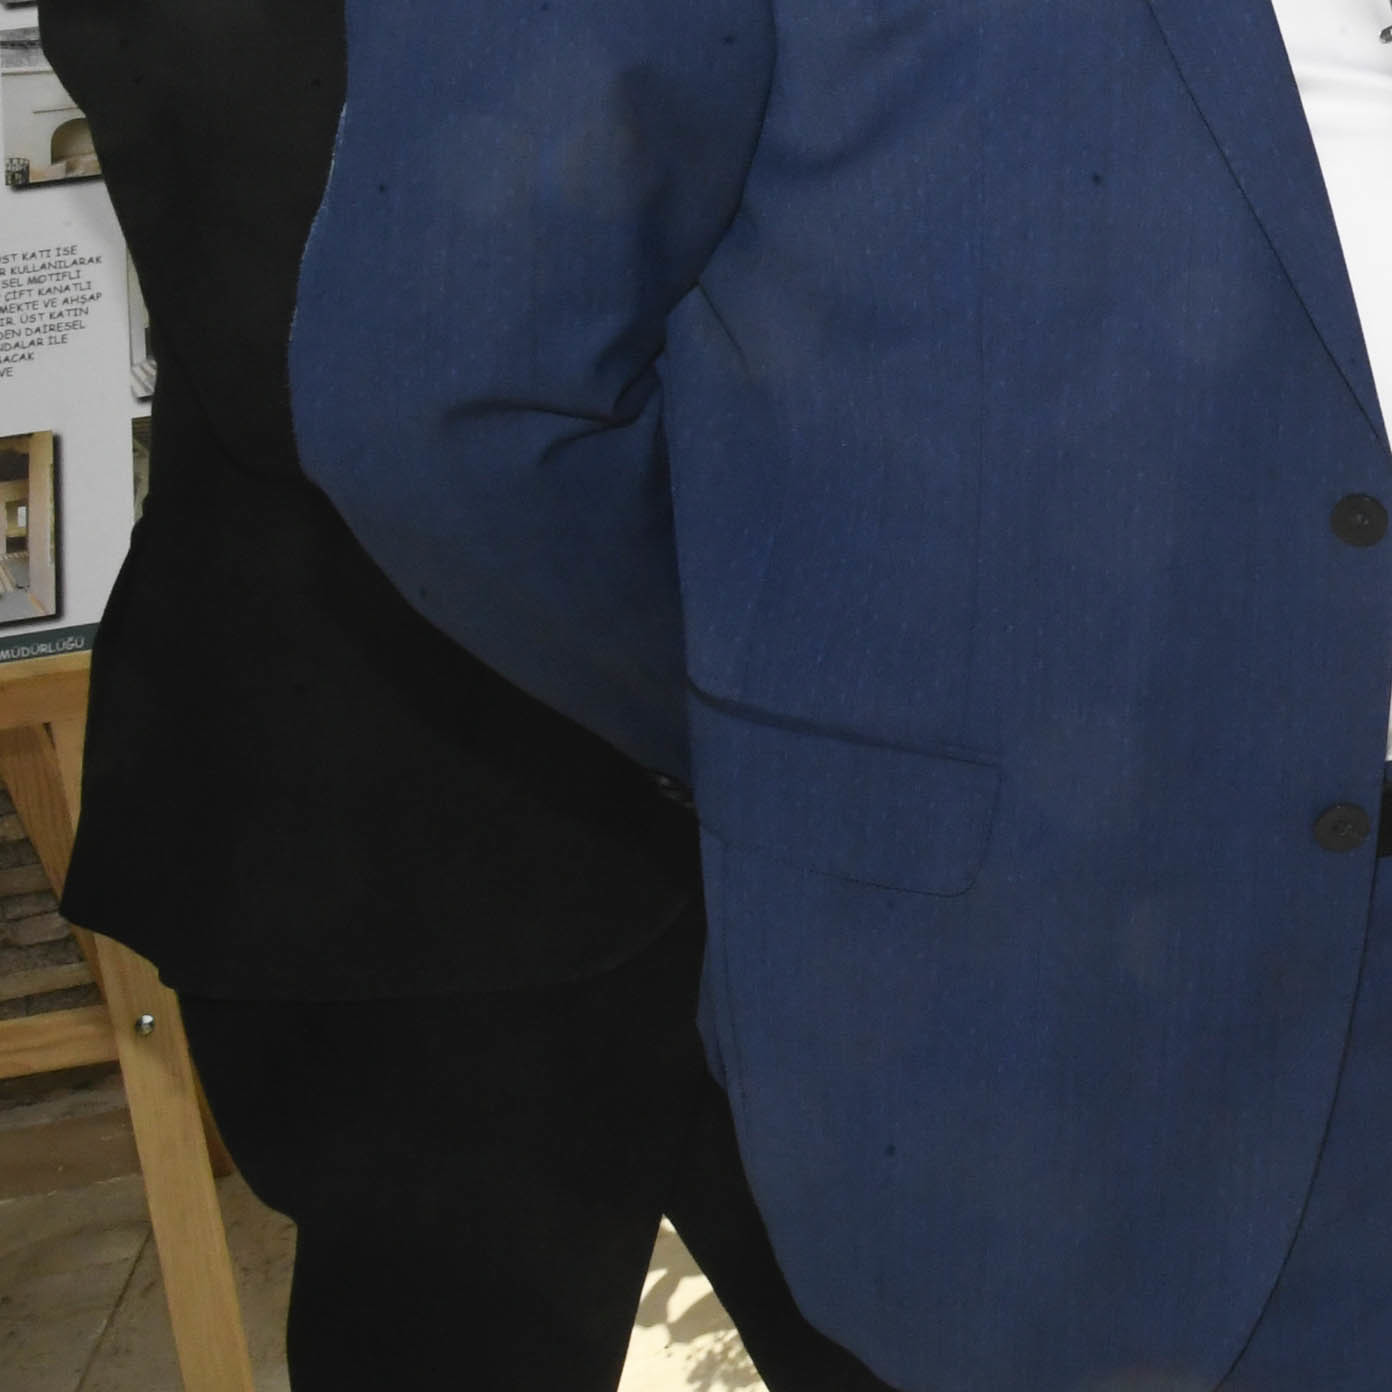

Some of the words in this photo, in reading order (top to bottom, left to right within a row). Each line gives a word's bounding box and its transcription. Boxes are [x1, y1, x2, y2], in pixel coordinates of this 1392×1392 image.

[10, 256, 103, 275] KULLANILARAK
[37, 280, 92, 297] KANATLI
[43, 297, 57, 309] VE
[62, 291, 103, 306] AHŞAP
[49, 306, 89, 320] KATIN
